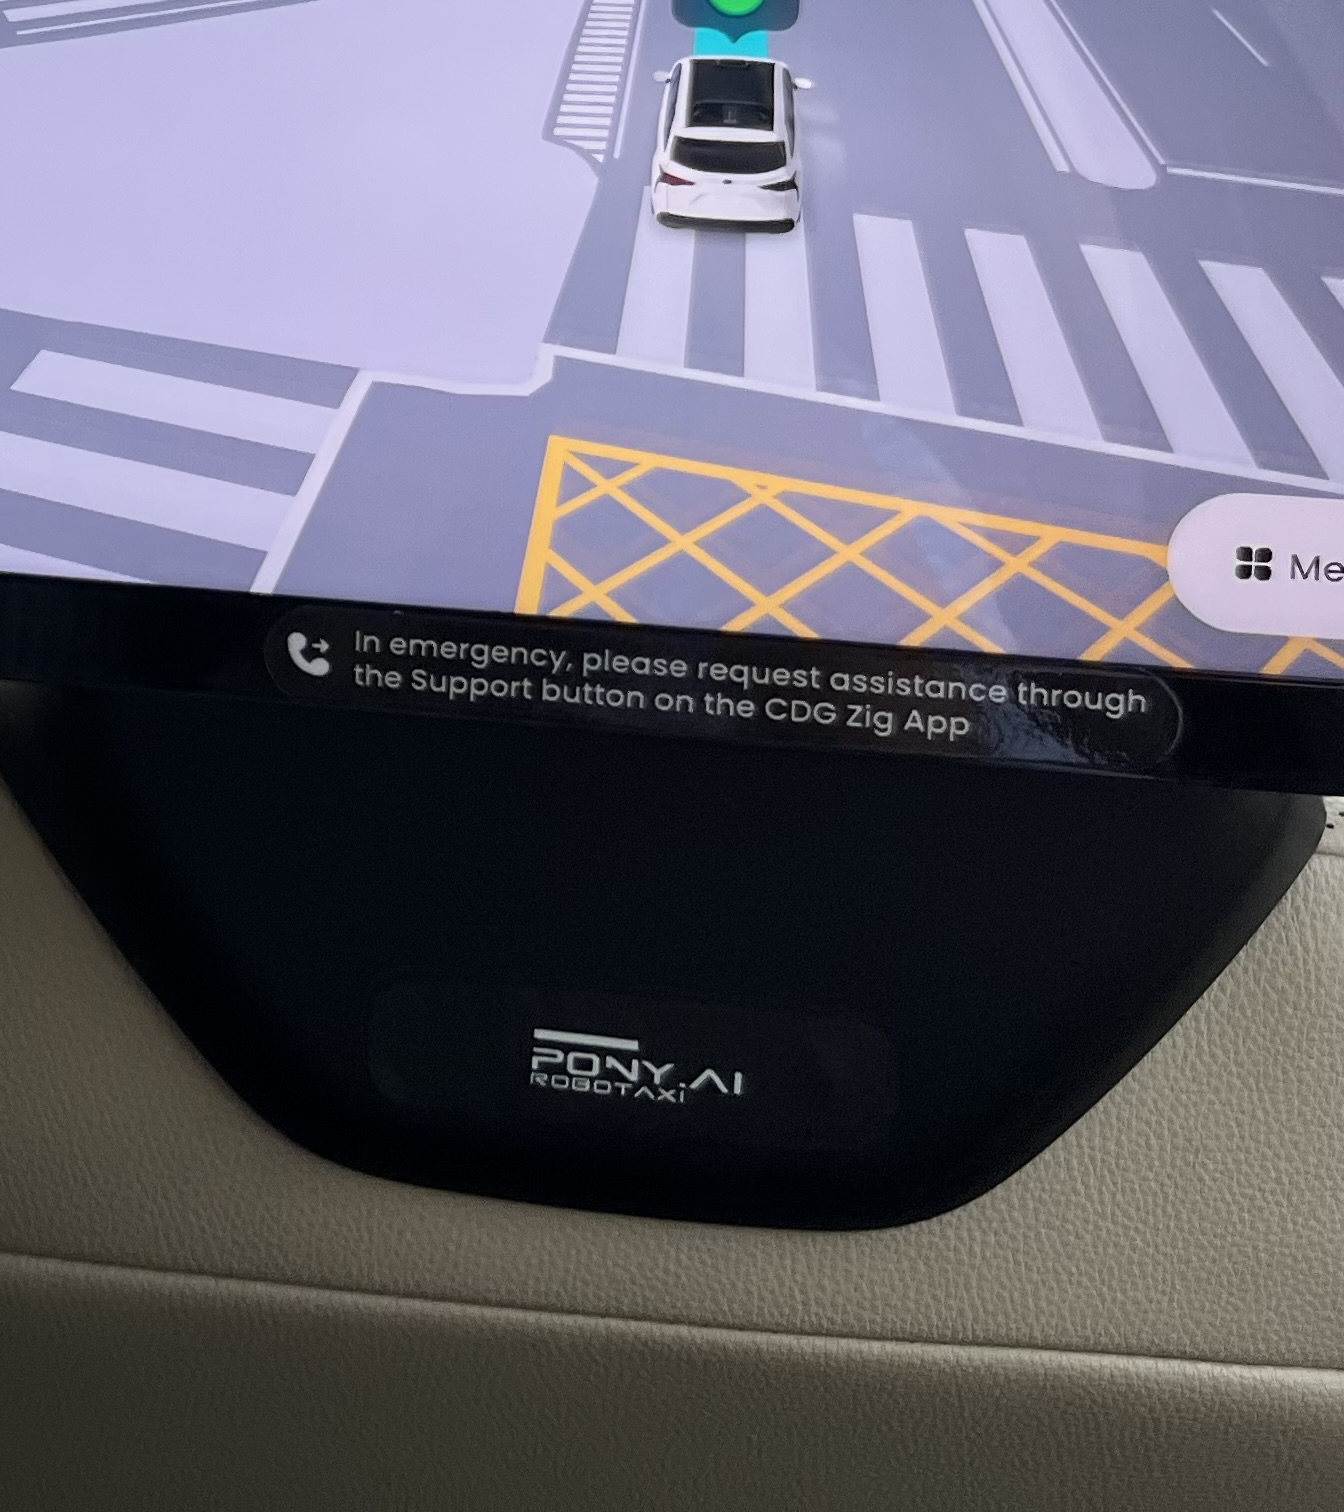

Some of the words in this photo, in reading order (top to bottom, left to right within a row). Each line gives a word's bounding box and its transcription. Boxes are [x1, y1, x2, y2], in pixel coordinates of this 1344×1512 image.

[353, 663, 402, 689] the
[411, 668, 533, 702] Support
[541, 677, 645, 709] button
[654, 692, 695, 713] on
[703, 691, 756, 718] the
[764, 697, 837, 725] CDG
[846, 703, 894, 737] Zig
[903, 709, 971, 742] App
[355, 630, 381, 653] In
[389, 637, 573, 675] emergency,
[582, 648, 688, 678] please
[697, 661, 821, 690] request
[829, 670, 1008, 703] assistance
[1017, 681, 1147, 720] through
